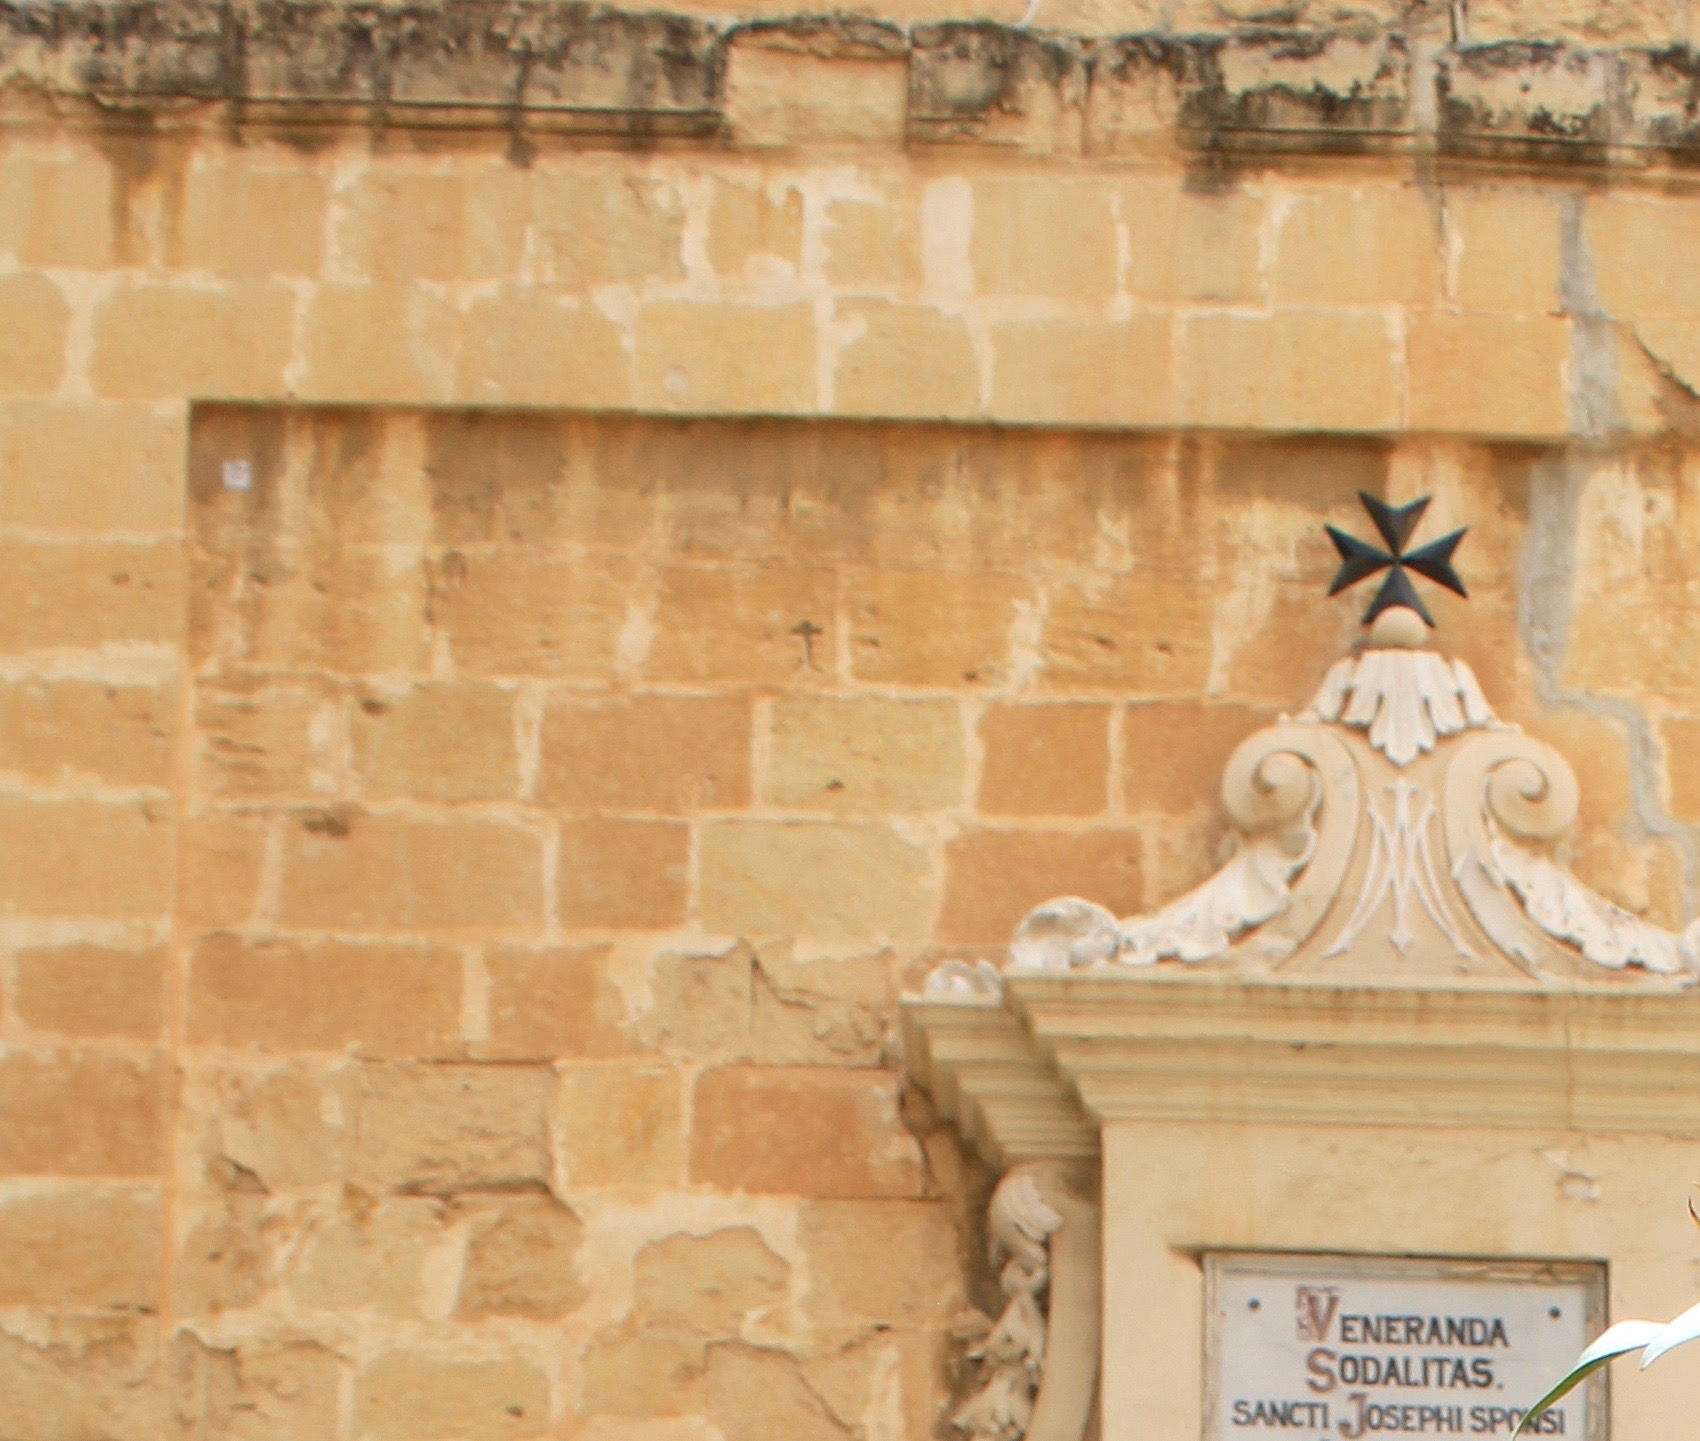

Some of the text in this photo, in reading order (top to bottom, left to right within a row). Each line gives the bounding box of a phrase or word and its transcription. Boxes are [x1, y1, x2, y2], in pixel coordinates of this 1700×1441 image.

[1296, 1285, 1509, 1347] VENERANDA
[1233, 1400, 1328, 1429] SANCTI
[1339, 1392, 1462, 1439] JOSEPHI
